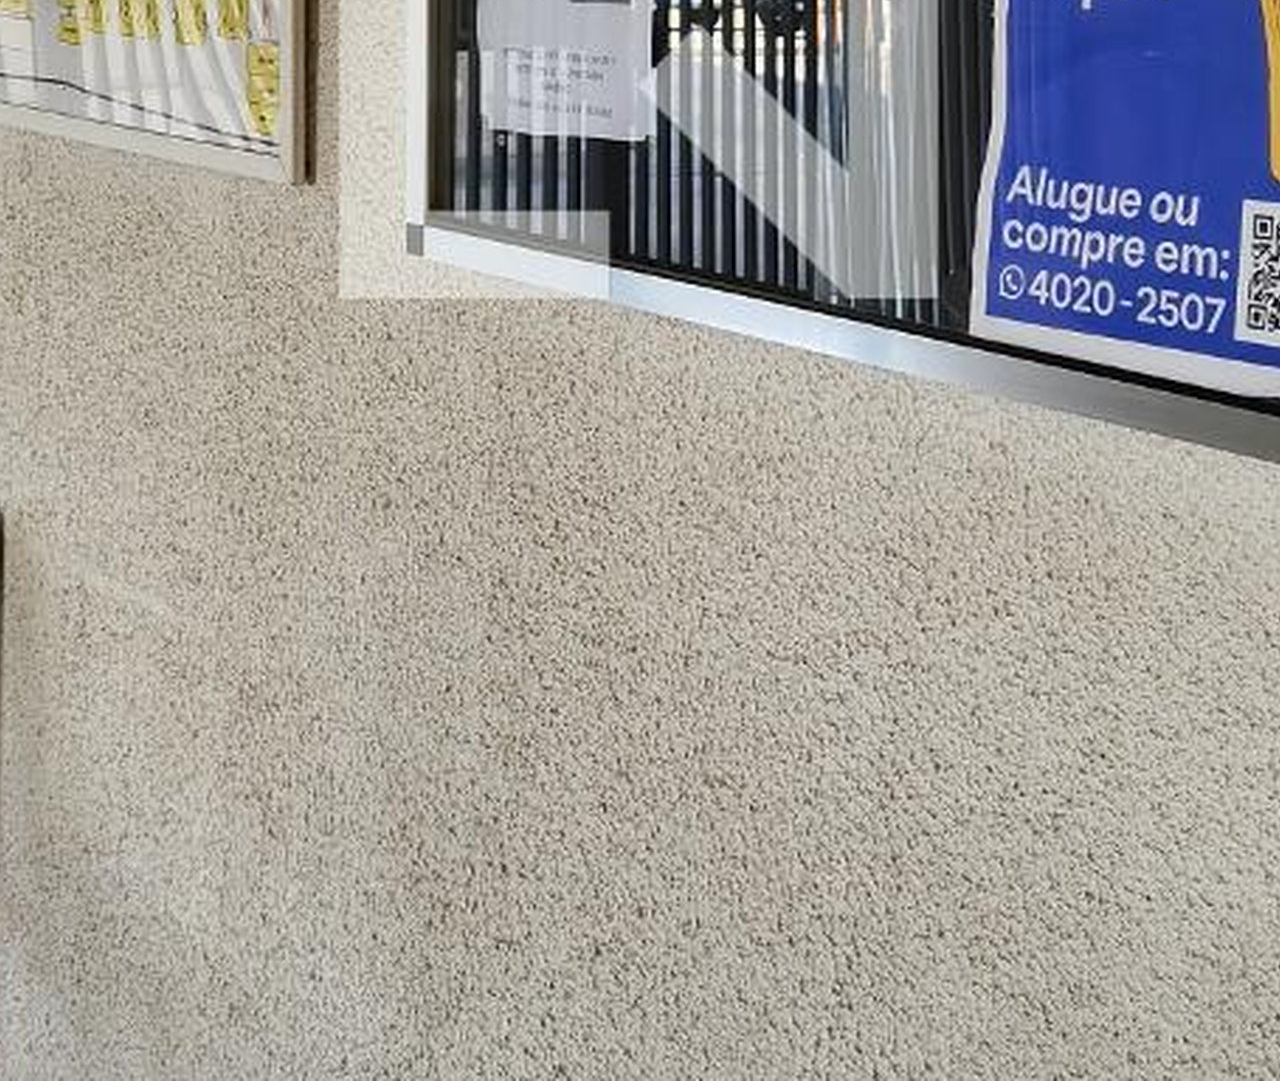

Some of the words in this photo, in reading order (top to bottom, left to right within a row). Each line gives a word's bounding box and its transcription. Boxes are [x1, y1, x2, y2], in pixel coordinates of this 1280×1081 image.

[1005, 164, 1142, 222] Alugue
[1149, 189, 1200, 227] ou
[1002, 218, 1145, 270] compre
[1155, 241, 1231, 282] em:
